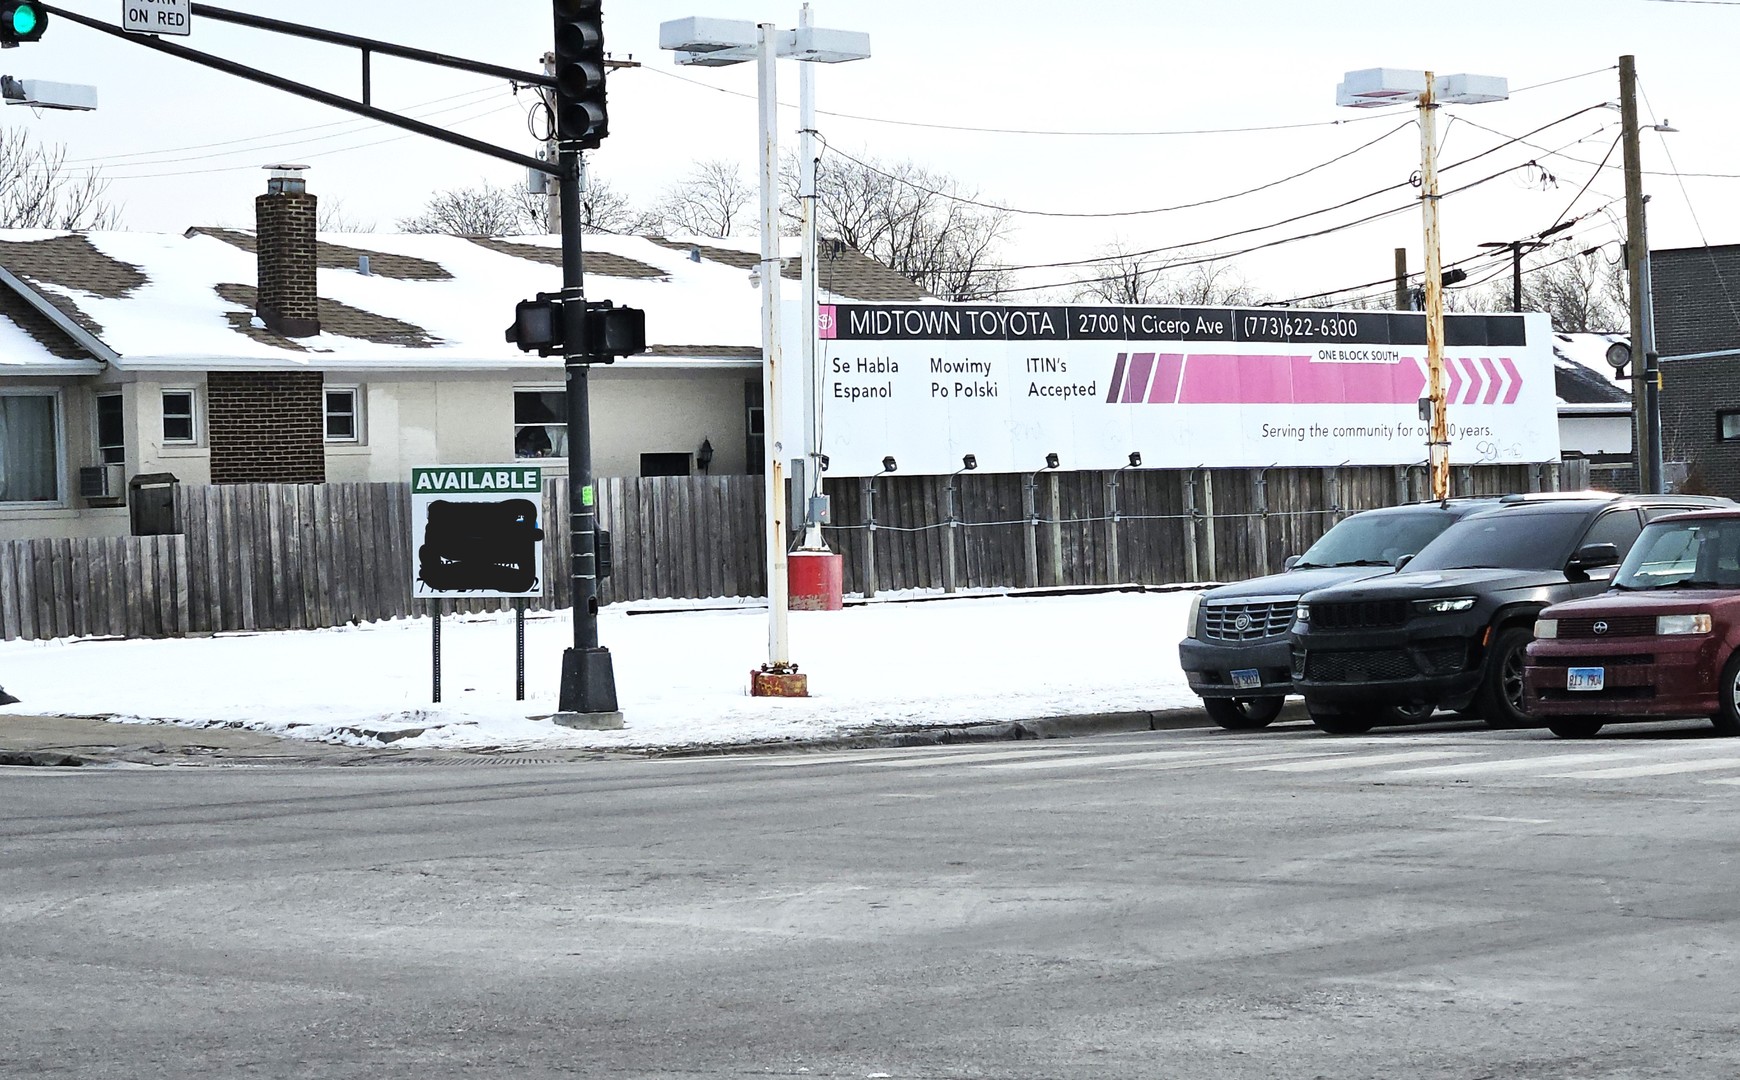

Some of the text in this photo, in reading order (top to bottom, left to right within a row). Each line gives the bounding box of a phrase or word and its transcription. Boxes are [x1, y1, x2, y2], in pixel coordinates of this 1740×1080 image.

[129, 8, 185, 27] ON RED
[850, 310, 1358, 338] MIDTOWN TOYOTA 2700 N Cicero Ave (773)622-6300
[832, 356, 899, 374] Se Habla
[1026, 357, 1067, 373] ITIN's
[1318, 350, 1399, 362] ONE BLOCK SOUTH
[930, 357, 992, 378] Mowimy
[834, 381, 892, 403] Espanol
[931, 380, 998, 398] Po Polski
[1027, 380, 1097, 401] Accepted
[1261, 423, 1306, 442] Serving
[1309, 422, 1329, 438] the
[1332, 423, 1394, 442] community
[1397, 422, 1414, 438] for
[1446, 422, 1457, 437] 0
[1459, 426, 1494, 441] years.
[416, 470, 537, 490] AVAILABLE
